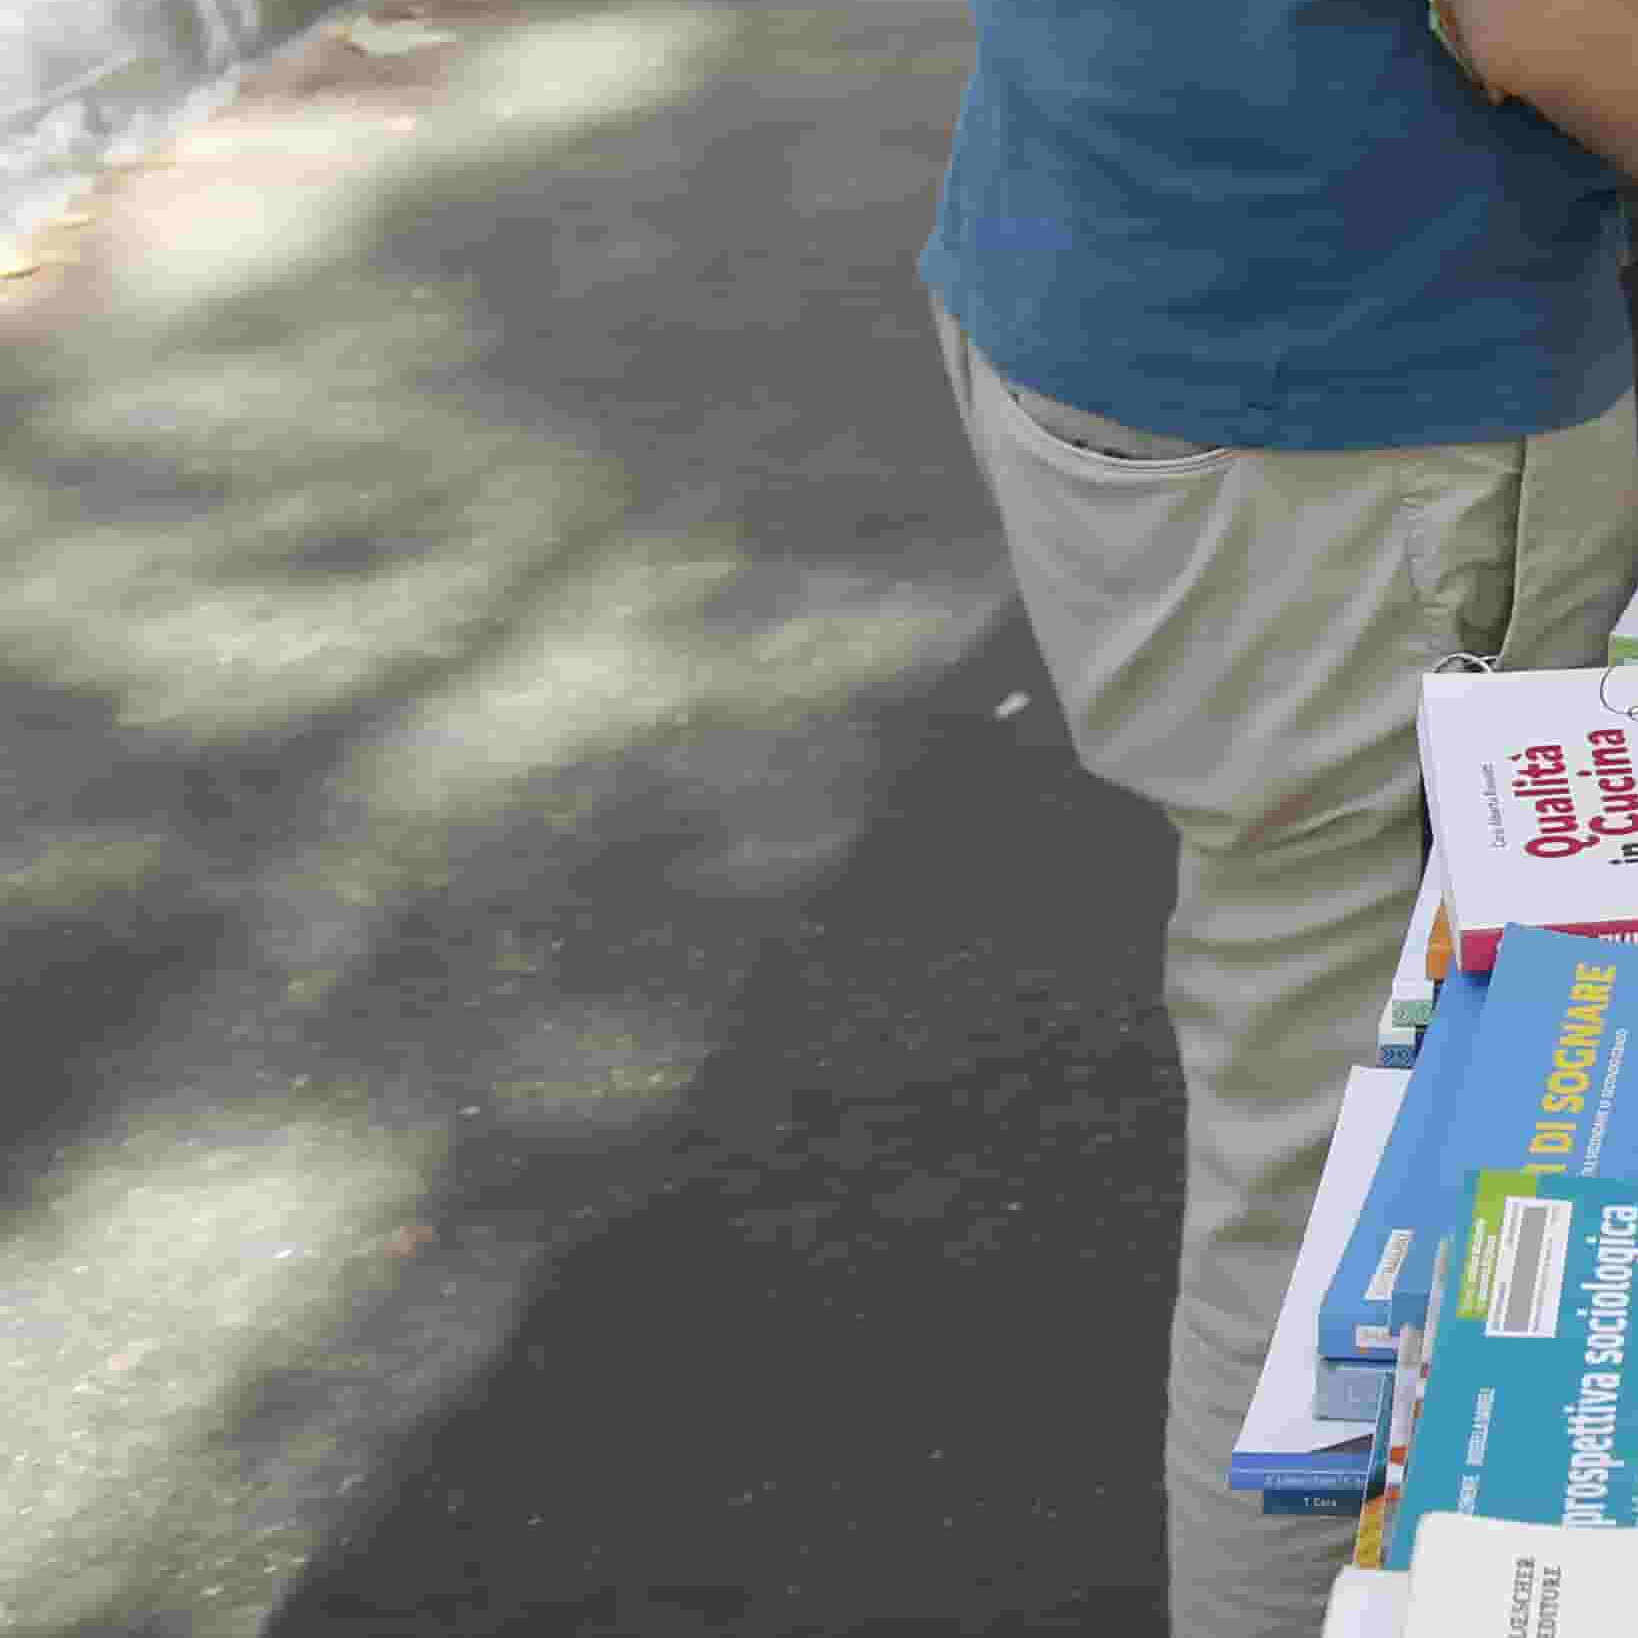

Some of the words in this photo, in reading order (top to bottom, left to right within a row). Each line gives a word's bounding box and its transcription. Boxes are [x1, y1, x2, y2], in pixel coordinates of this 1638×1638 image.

[1507, 744, 1602, 858] Qualità
[1541, 961, 1617, 1113] SOGNARE
[1529, 1121, 1578, 1155] DI
[1560, 1372, 1625, 1530] prospettiva
